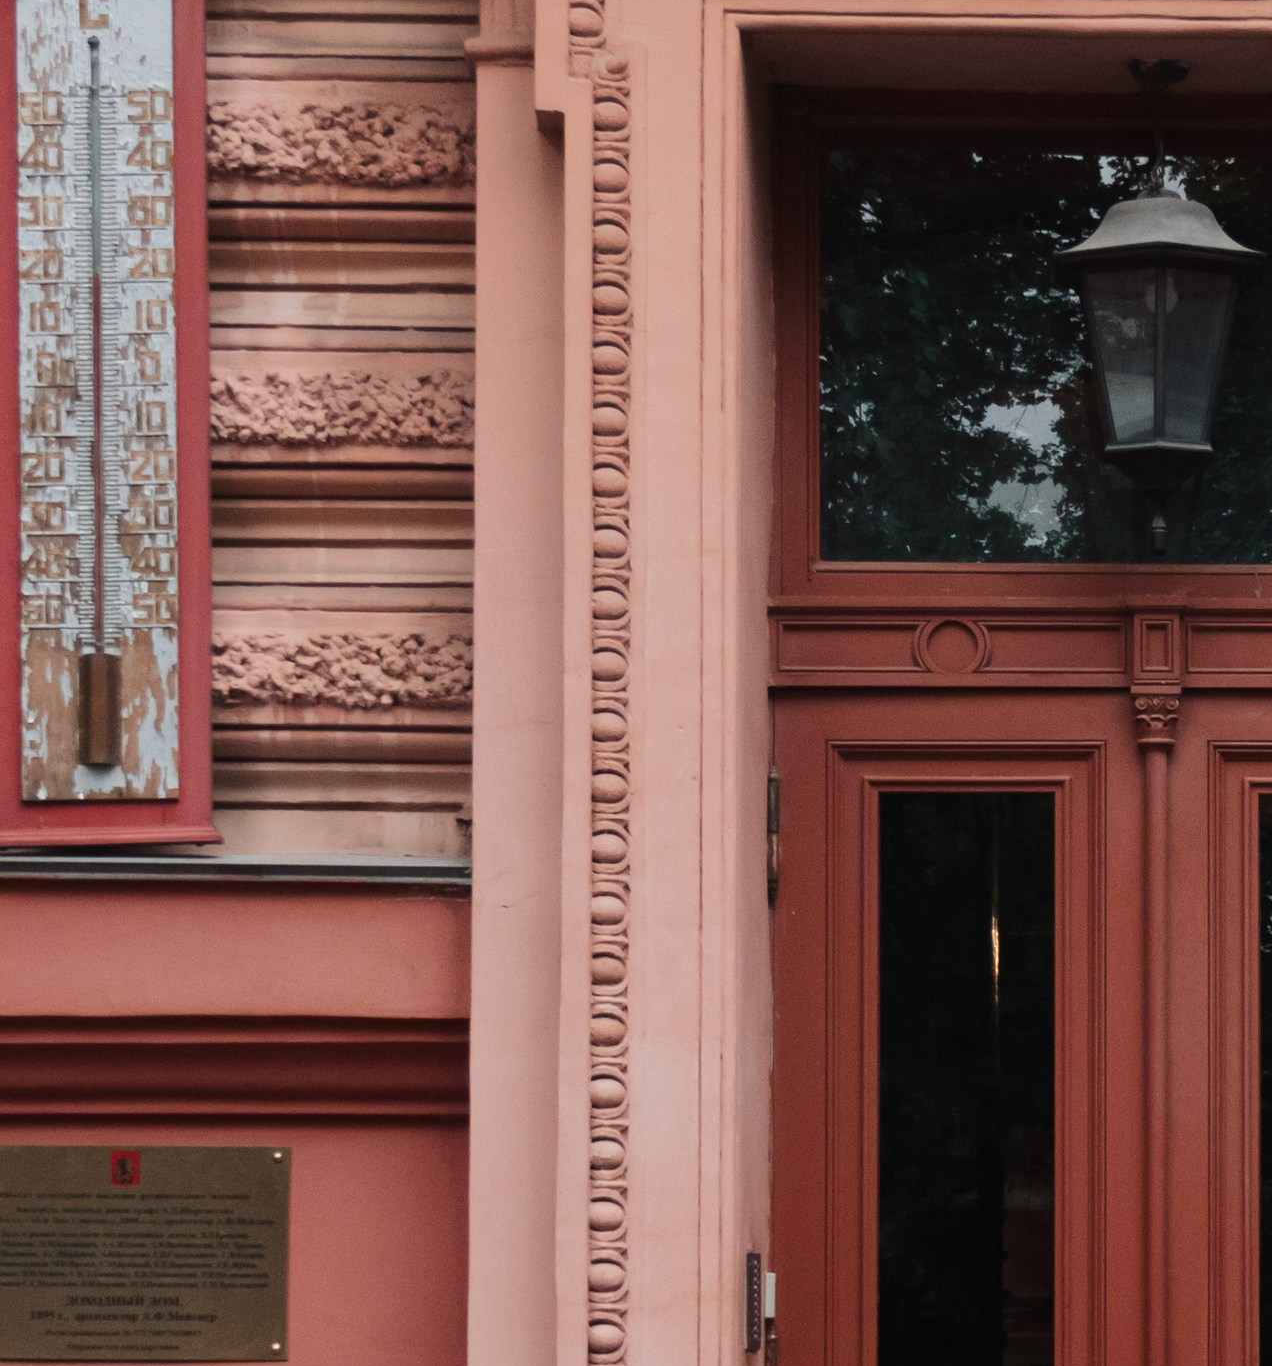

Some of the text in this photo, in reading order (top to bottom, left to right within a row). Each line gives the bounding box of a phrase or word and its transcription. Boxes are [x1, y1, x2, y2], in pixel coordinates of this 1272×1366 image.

[20, 90, 172, 123] 50 50
[20, 141, 172, 172] 40 40
[20, 196, 63, 227] 30
[20, 248, 173, 280] 20 20
[29, 300, 166, 332] 10 10
[136, 402, 166, 432] 10
[22, 450, 175, 482] 20 20
[131, 547, 175, 577] 40
[132, 594, 177, 624] 50
